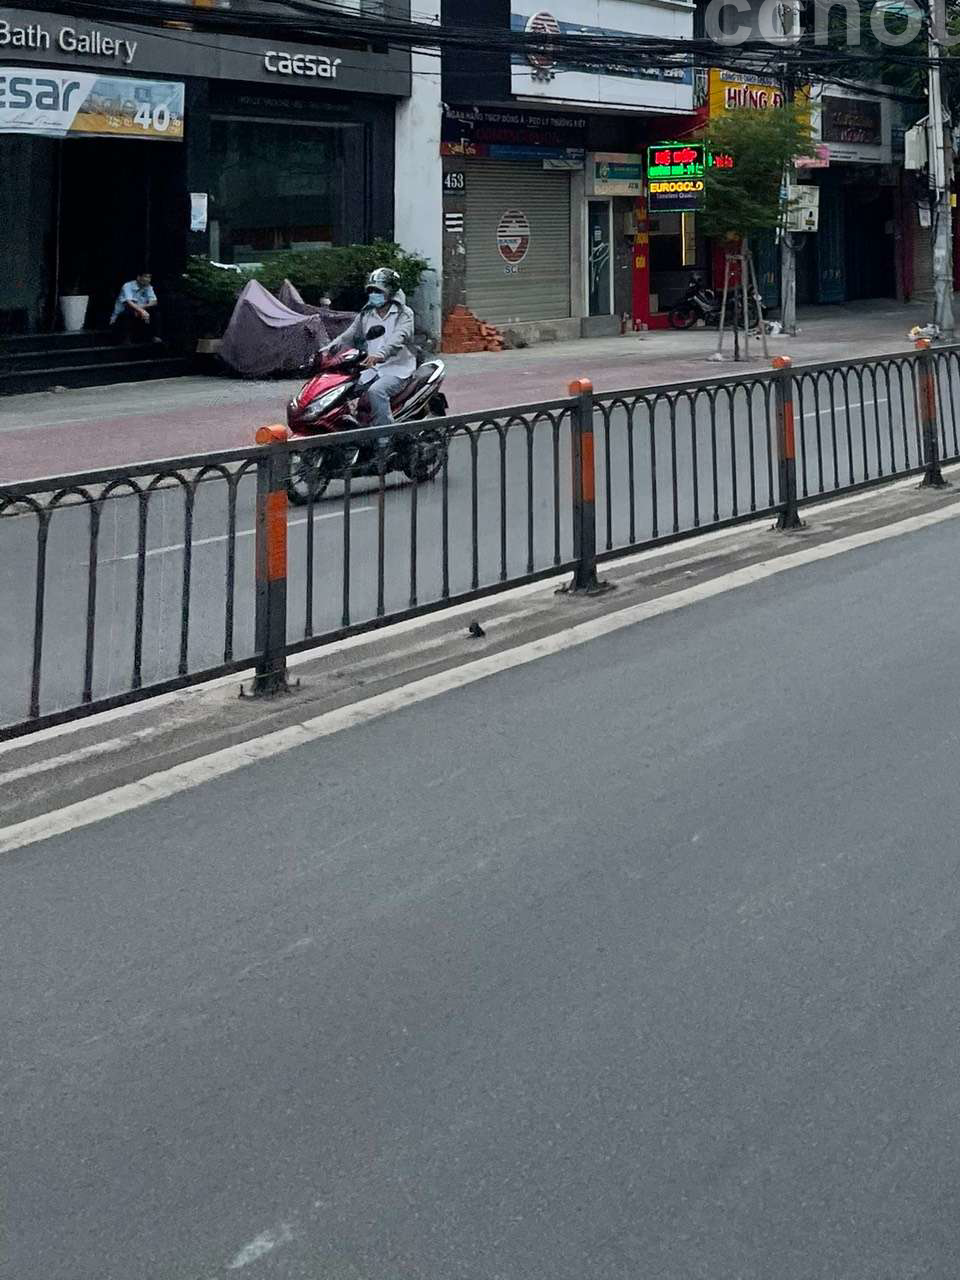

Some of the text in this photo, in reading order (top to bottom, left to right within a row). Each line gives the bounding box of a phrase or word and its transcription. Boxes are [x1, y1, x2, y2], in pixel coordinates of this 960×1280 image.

[59, 27, 138, 63] Gallery
[444, 172, 464, 188] 453
[650, 181, 704, 193] EUROGOLD
